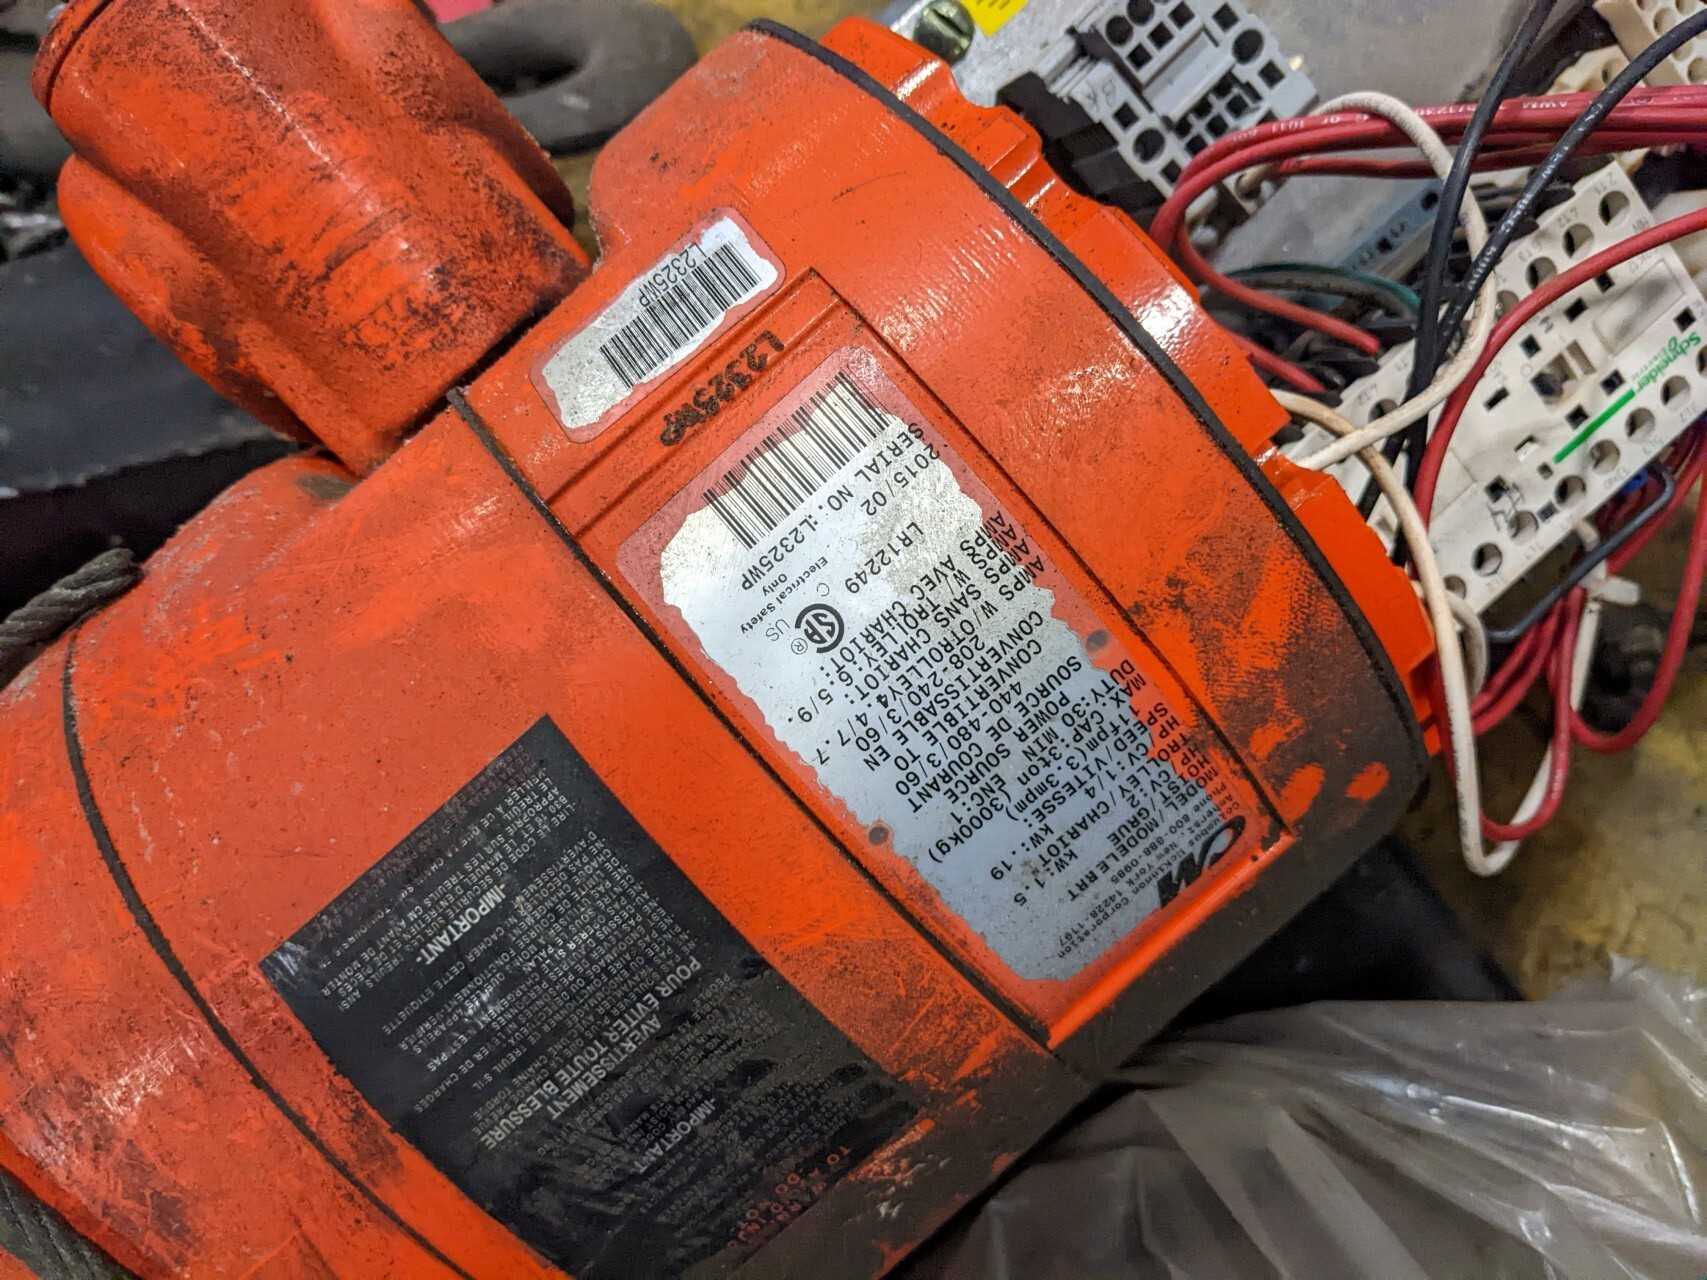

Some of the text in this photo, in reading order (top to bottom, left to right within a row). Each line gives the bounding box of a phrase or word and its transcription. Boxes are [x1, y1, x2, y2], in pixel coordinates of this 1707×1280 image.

[631, 241, 706, 309] L2325WP
[1634, 330, 1702, 393] Schneider
[853, 420, 925, 488] SERIAL
[858, 441, 941, 518] 2015/02
[841, 520, 924, 596] LR12249
[968, 522, 1020, 571] AMPS
[737, 554, 829, 637] Electrical Safety
[758, 571, 789, 599] Only
[817, 509, 1009, 681] AMPS AVEC CHARIOT:
[996, 554, 1048, 603] AMPS
[762, 615, 791, 645] US
[842, 537, 1033, 708] AMPS SANS CHARIOT:
[852, 633, 986, 754] 208-240/3/60
[861, 608, 1045, 772] CONVERTISSABLE EN
[891, 636, 1043, 773] CONVERTIBLE TO
[892, 678, 1025, 797] 440-480/3/60
[904, 653, 1083, 813] SOURCE DE COURANT
[941, 689, 1070, 805] POWER SOURCE
[947, 657, 1135, 825] DUTY:30 MIN ENC:1
[1002, 701, 1141, 823] 11fpm(3.3mpm)
[1021, 700, 1169, 831] SPEED/VITESSE:
[1081, 714, 1180, 801] HP/CV:1/4
[1124, 741, 1201, 809] HP/CV:2
[537, 776, 553, 792] LE
[1034, 731, 1190, 867] TROLLEY/CHARIOT
[1105, 753, 1211, 847] HOIST/GRUE
[1190, 781, 1227, 815] Phone
[478, 810, 496, 827] CE
[501, 789, 538, 823] TREUIL
[1186, 799, 1241, 849] Columbus
[482, 832, 506, 856] SUR
[501, 837, 517, 853] LE
[518, 822, 534, 838] ET
[535, 823, 551, 839] LE
[924, 786, 1013, 866] (3000kg)
[462, 850, 503, 887] MANUEL
[463, 851, 484, 871] LES
[492, 860, 509, 877] DE
[507, 835, 537, 863] CODE
[567, 852, 589, 874] PAS
[1153, 840, 1178, 863] New
[422, 868, 464, 907] TREUILS
[589, 877, 611, 899] PAS
[1124, 860, 1154, 888] York
[405, 904, 423, 921] CM
[506, 847, 612, 941] CHAQUE CHANGEMENT
[514, 855, 620, 949] DE LIMITE DE COURSE
[605, 895, 627, 917] PAS
[374, 917, 407, 949] AVANT
[422, 914, 445, 936] SUR
[520, 907, 596, 975] SOUS LE PALAN
[620, 911, 642, 933] PAS
[636, 928, 658, 949] PAS
[1055, 894, 1130, 960] Corporation
[359, 945, 376, 963] DE
[372, 950, 388, 966] DE
[386, 938, 402, 954] ET
[464, 924, 505, 963] CACHER
[553, 947, 566, 962] SI
[568, 906, 666, 993] EST OU
[628, 954, 645, 971] OU
[319, 958, 362, 997] MONTER
[429, 959, 466, 992] CETTE
[538, 958, 554, 974] LE
[574, 957, 590, 974] DE
[654, 954, 701, 999] POUR
[336, 987, 362, 1013] ANSI
[601, 991, 660, 1045] ÉVITER
[426, 1051, 448, 1073] PAS
[457, 1057, 474, 1074] DE
[544, 1013, 662, 1119] AVERTISSEMENT
[553, 1036, 607, 1086] TOUTE
[412, 1070, 459, 1114] CHARGES
[478, 1077, 559, 1151] BLESSURE
